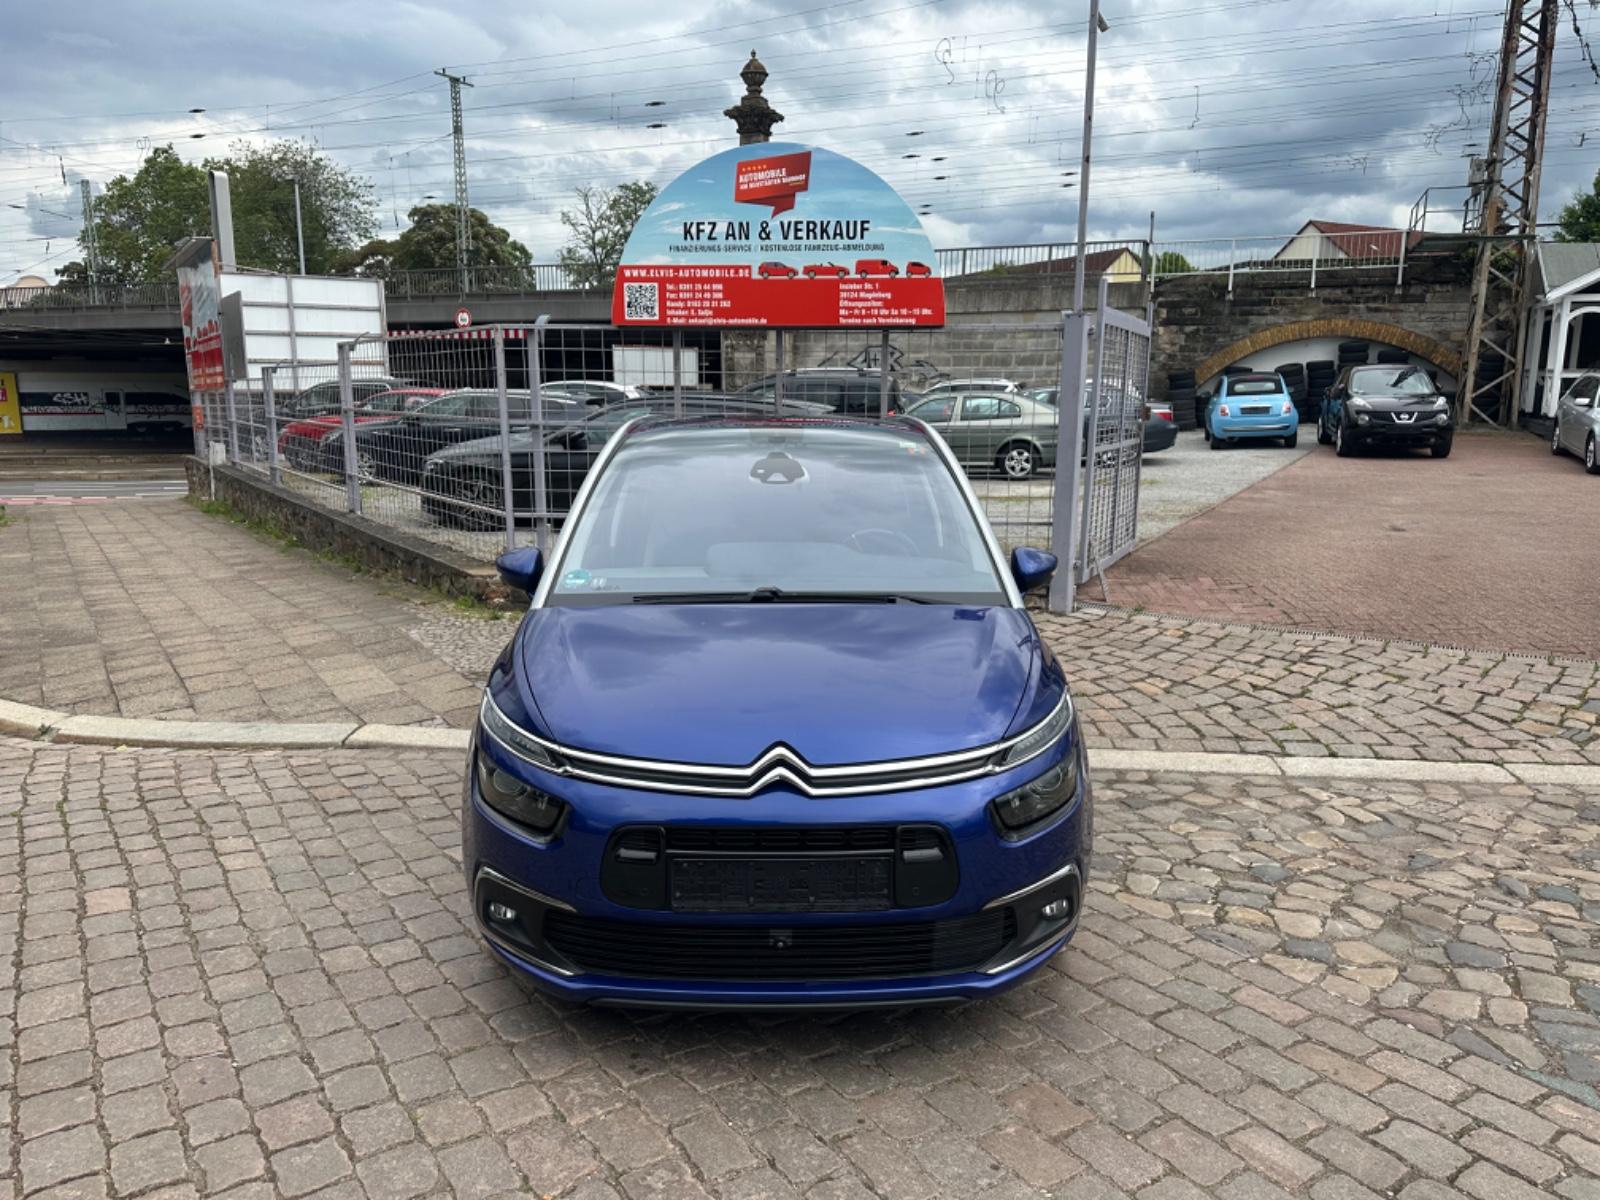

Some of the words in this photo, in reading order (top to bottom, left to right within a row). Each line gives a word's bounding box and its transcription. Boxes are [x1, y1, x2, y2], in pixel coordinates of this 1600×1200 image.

[739, 167, 786, 183] AUTOMOBILE
[683, 221, 717, 240] KFZ
[725, 221, 750, 240] AN
[759, 221, 771, 240] &
[779, 220, 871, 240] VERKAUF
[669, 244, 752, 253] FINANZIERUNGS-SERVICE
[760, 244, 802, 252] KOSTENLOSE
[804, 243, 885, 252] FAHRZEUG-ABMELDUNG
[623, 269, 750, 278] WWW.ELVIS-AUTOMOBILE.DE
